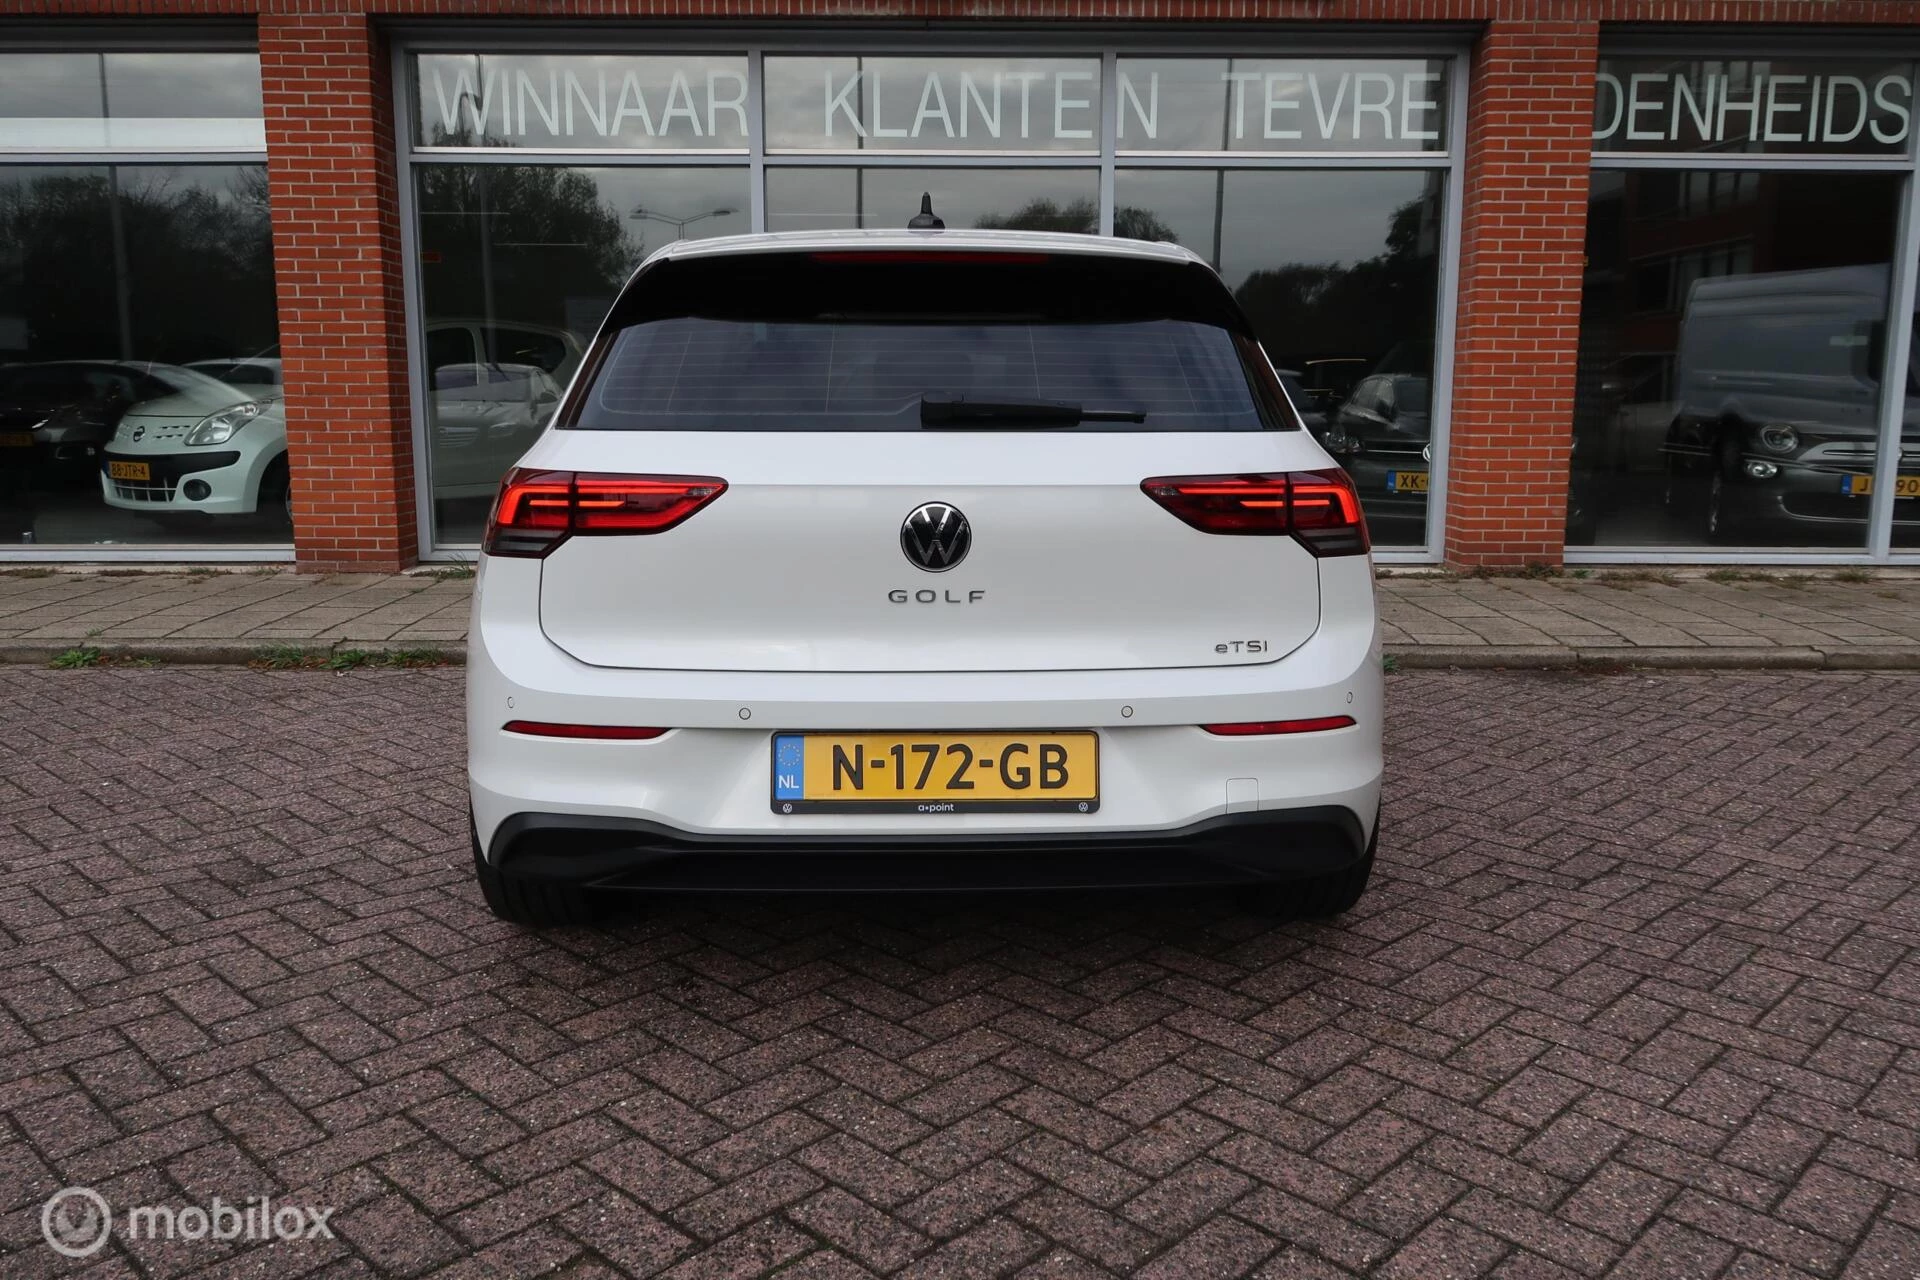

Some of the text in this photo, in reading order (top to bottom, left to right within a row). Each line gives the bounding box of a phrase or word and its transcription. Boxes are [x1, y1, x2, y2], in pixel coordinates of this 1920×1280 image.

[433, 69, 748, 136] WINNAAR
[824, 70, 1159, 139] KLANTEN
[888, 590, 986, 604] GOLF
[1214, 640, 1268, 653] eTSI
[778, 743, 1069, 791] NL N-172-GB
